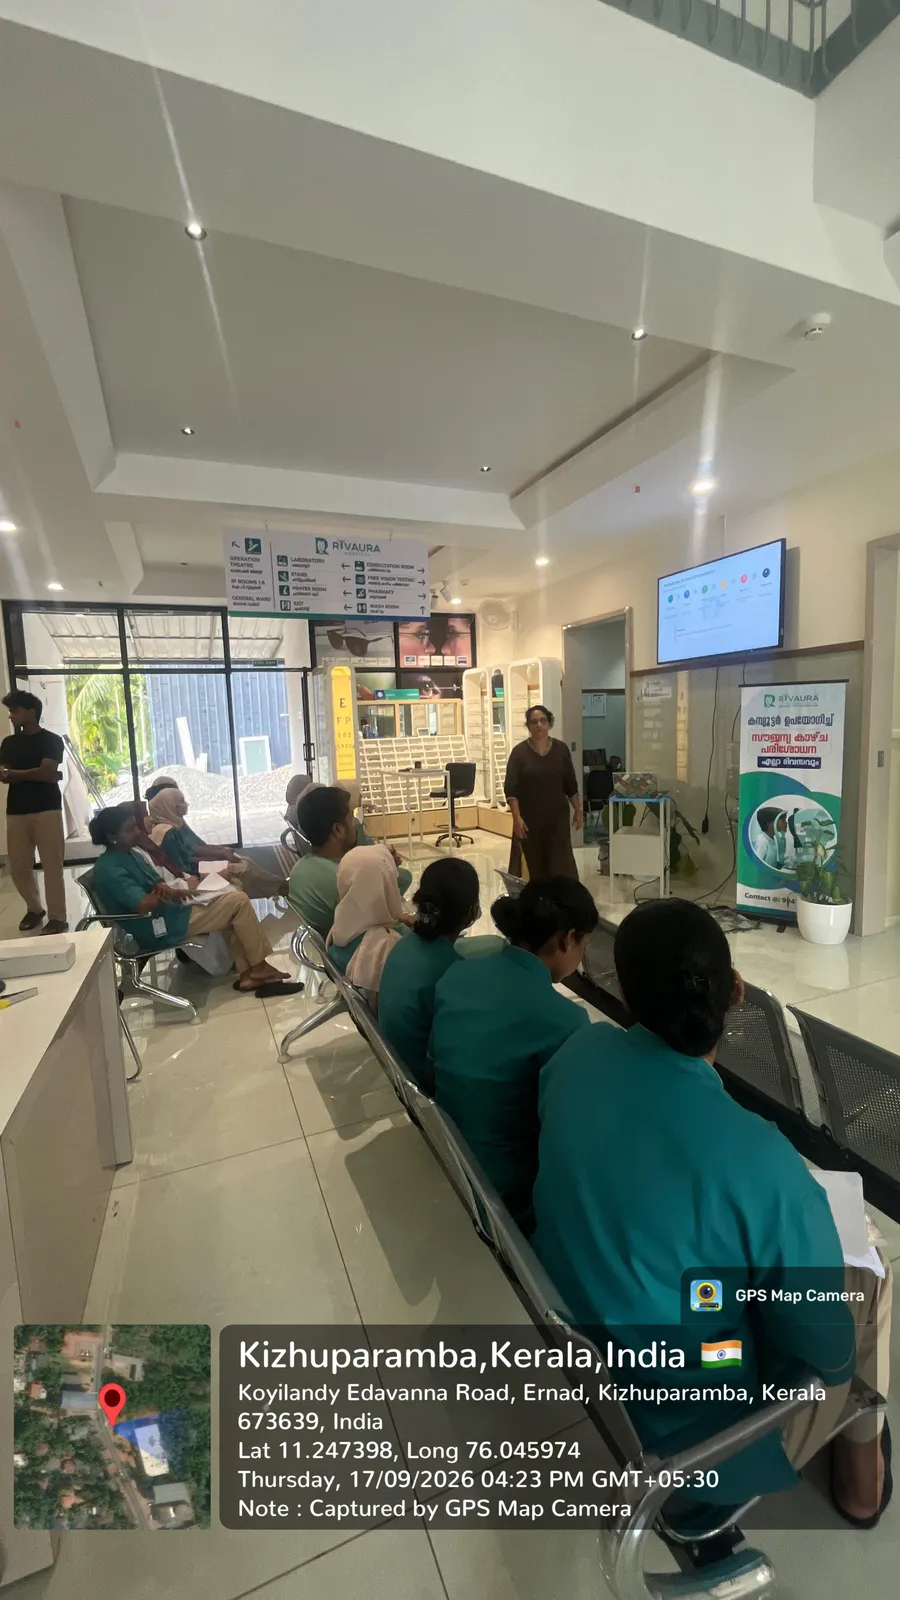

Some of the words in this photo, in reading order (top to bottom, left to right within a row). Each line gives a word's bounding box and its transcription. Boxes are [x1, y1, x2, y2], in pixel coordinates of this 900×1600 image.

[332, 540, 380, 553] RIVAURA
[778, 694, 820, 702] RIVAURA
[744, 893, 771, 901] Contact
